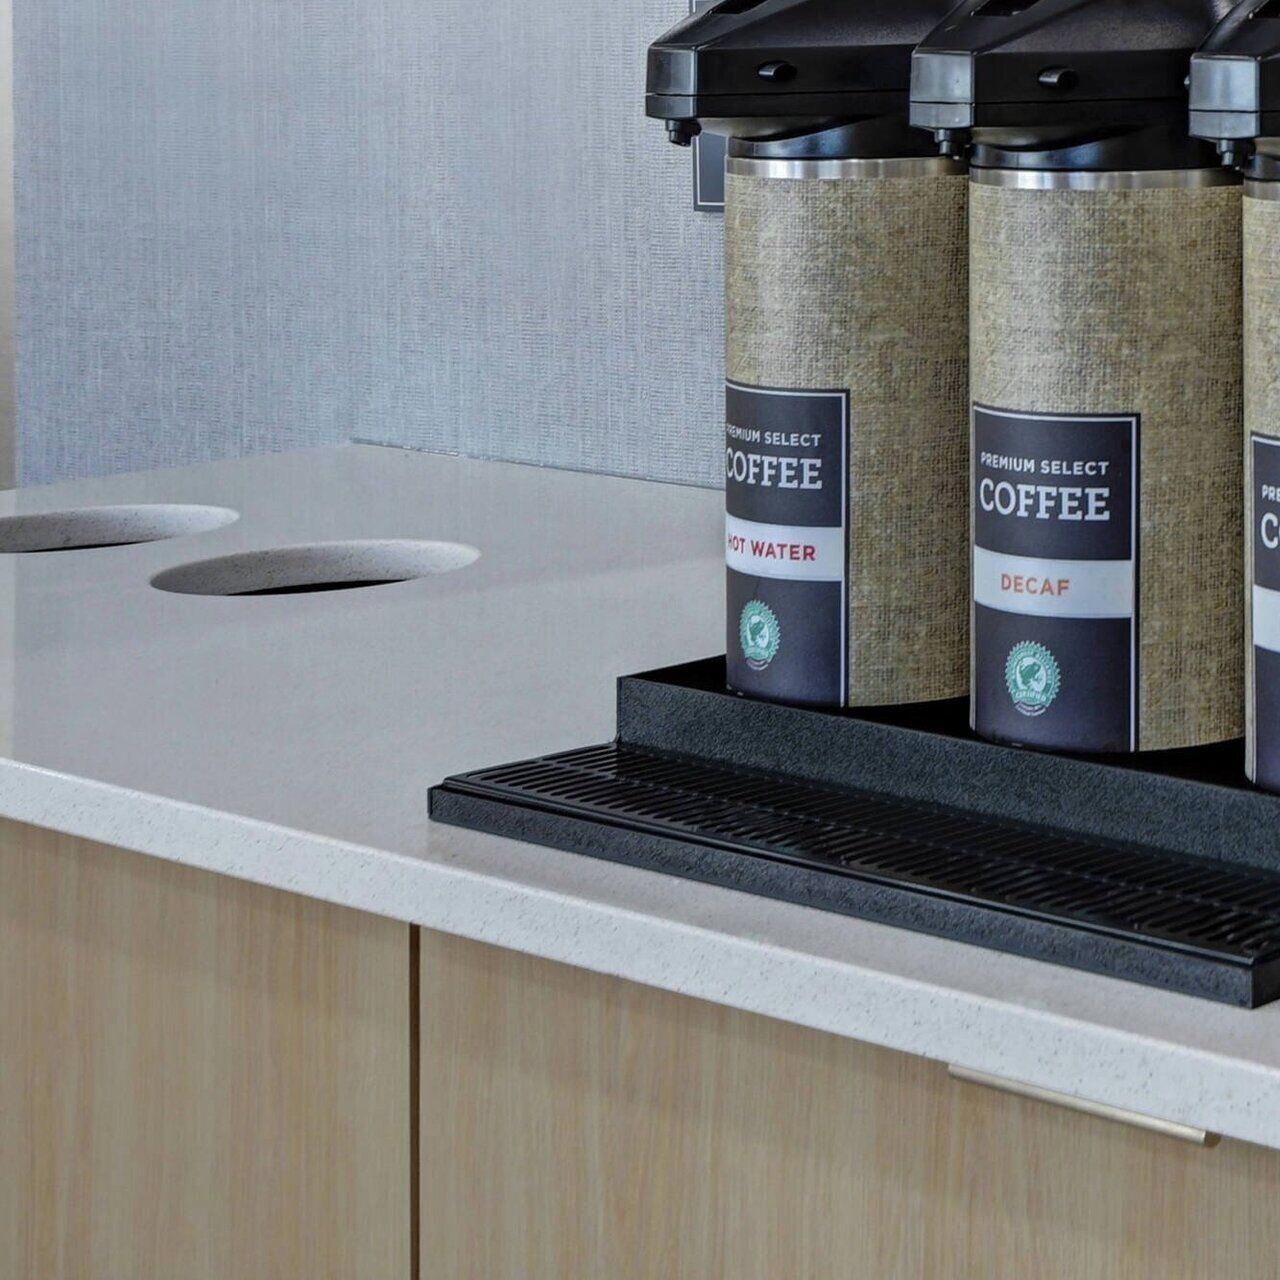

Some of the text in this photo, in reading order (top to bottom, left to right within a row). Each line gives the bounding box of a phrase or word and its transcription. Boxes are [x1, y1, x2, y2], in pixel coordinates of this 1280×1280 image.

[764, 431, 822, 447] SELECT
[726, 447, 823, 490] COFFEE
[980, 451, 1110, 476] PREMIUM SELECT
[979, 478, 1110, 521] COFFEE
[750, 540, 816, 561] WATER
[1001, 573, 1070, 597] DECAF
